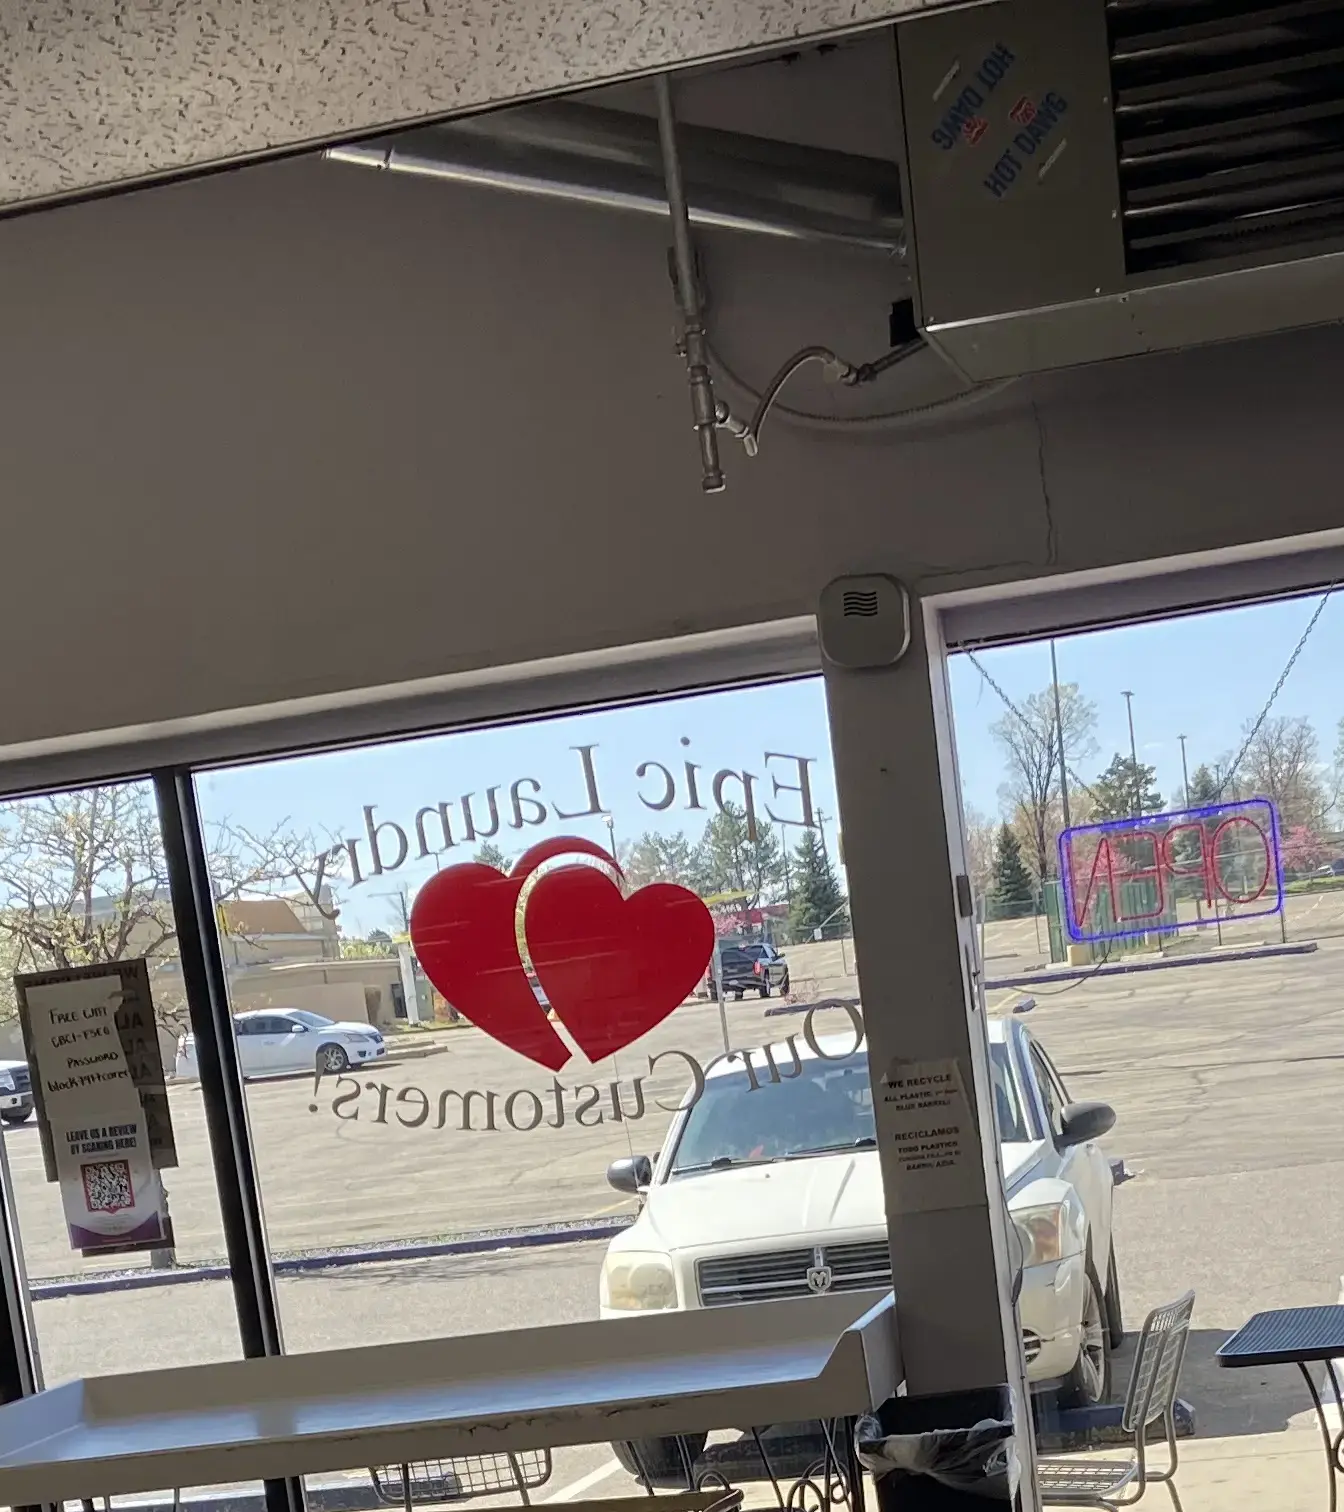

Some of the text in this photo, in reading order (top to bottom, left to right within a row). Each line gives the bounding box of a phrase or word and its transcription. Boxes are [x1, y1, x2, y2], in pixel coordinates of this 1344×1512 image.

[931, 43, 1016, 150] HOT DAWG
[983, 92, 1067, 198] HOT DAWG
[888, 1073, 952, 1089] WE RECYCLE
[66, 1123, 137, 1142] LEAVE US A REVIEW
[895, 1126, 960, 1141] RECICLAMOS
[70, 1142, 80, 1155] BY
